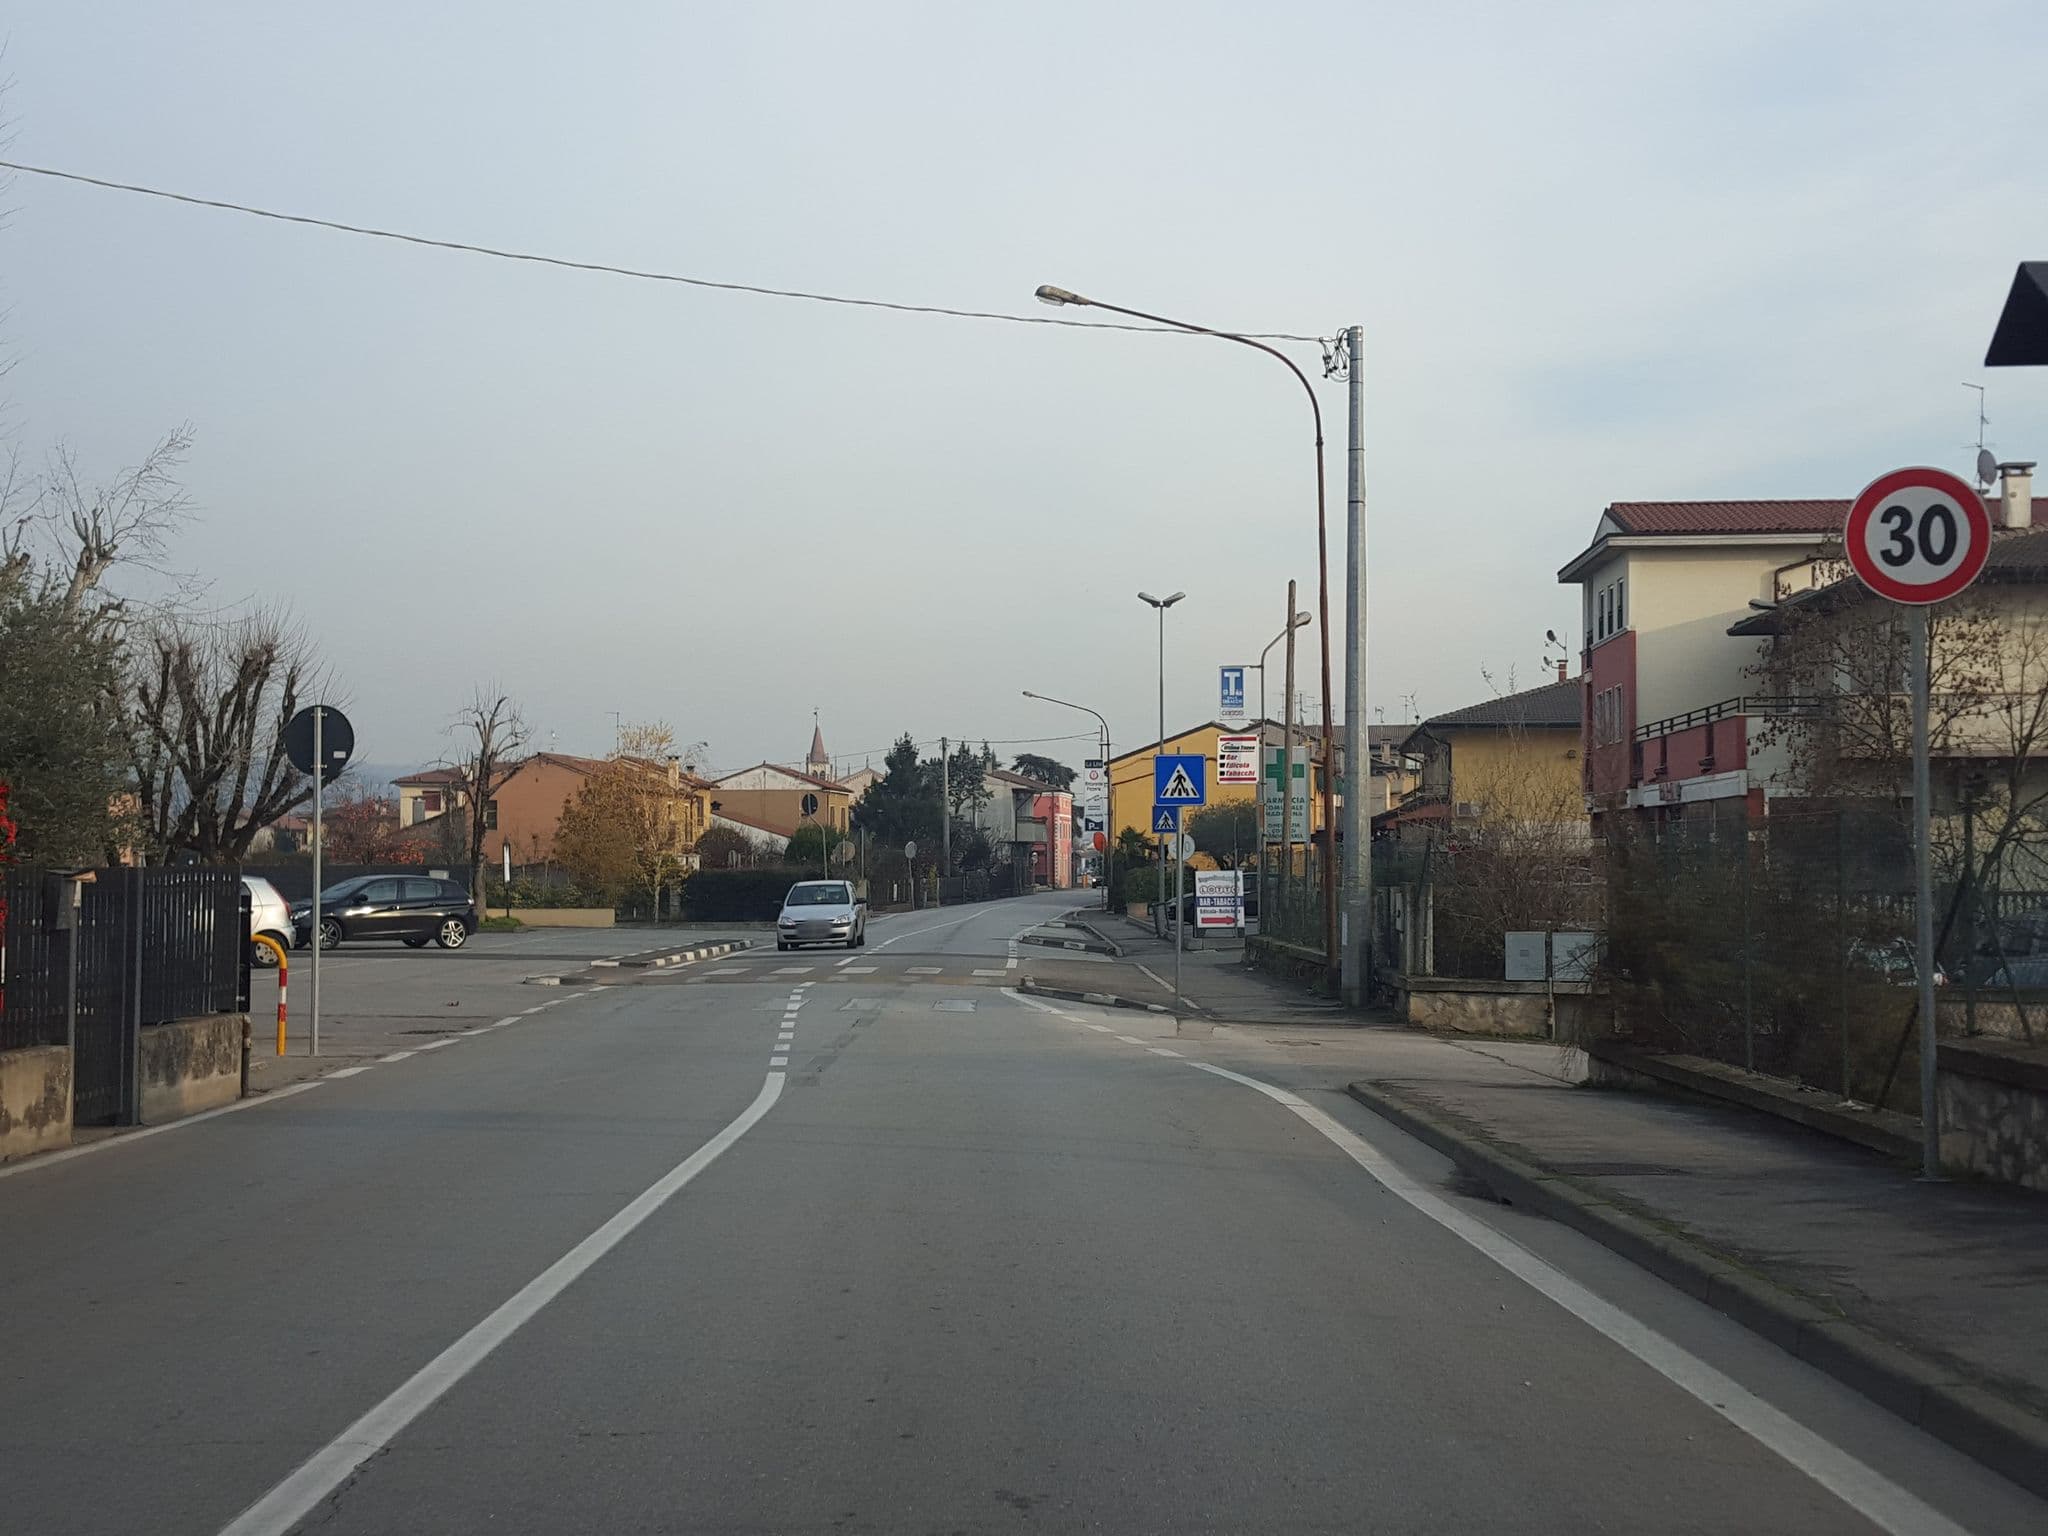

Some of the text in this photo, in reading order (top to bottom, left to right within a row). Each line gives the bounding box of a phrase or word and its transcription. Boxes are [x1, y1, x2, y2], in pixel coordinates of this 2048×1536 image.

[1880, 503, 1957, 567] 30
[1223, 671, 1241, 696] T
[1199, 897, 1241, 906] BAR-TABACCI
